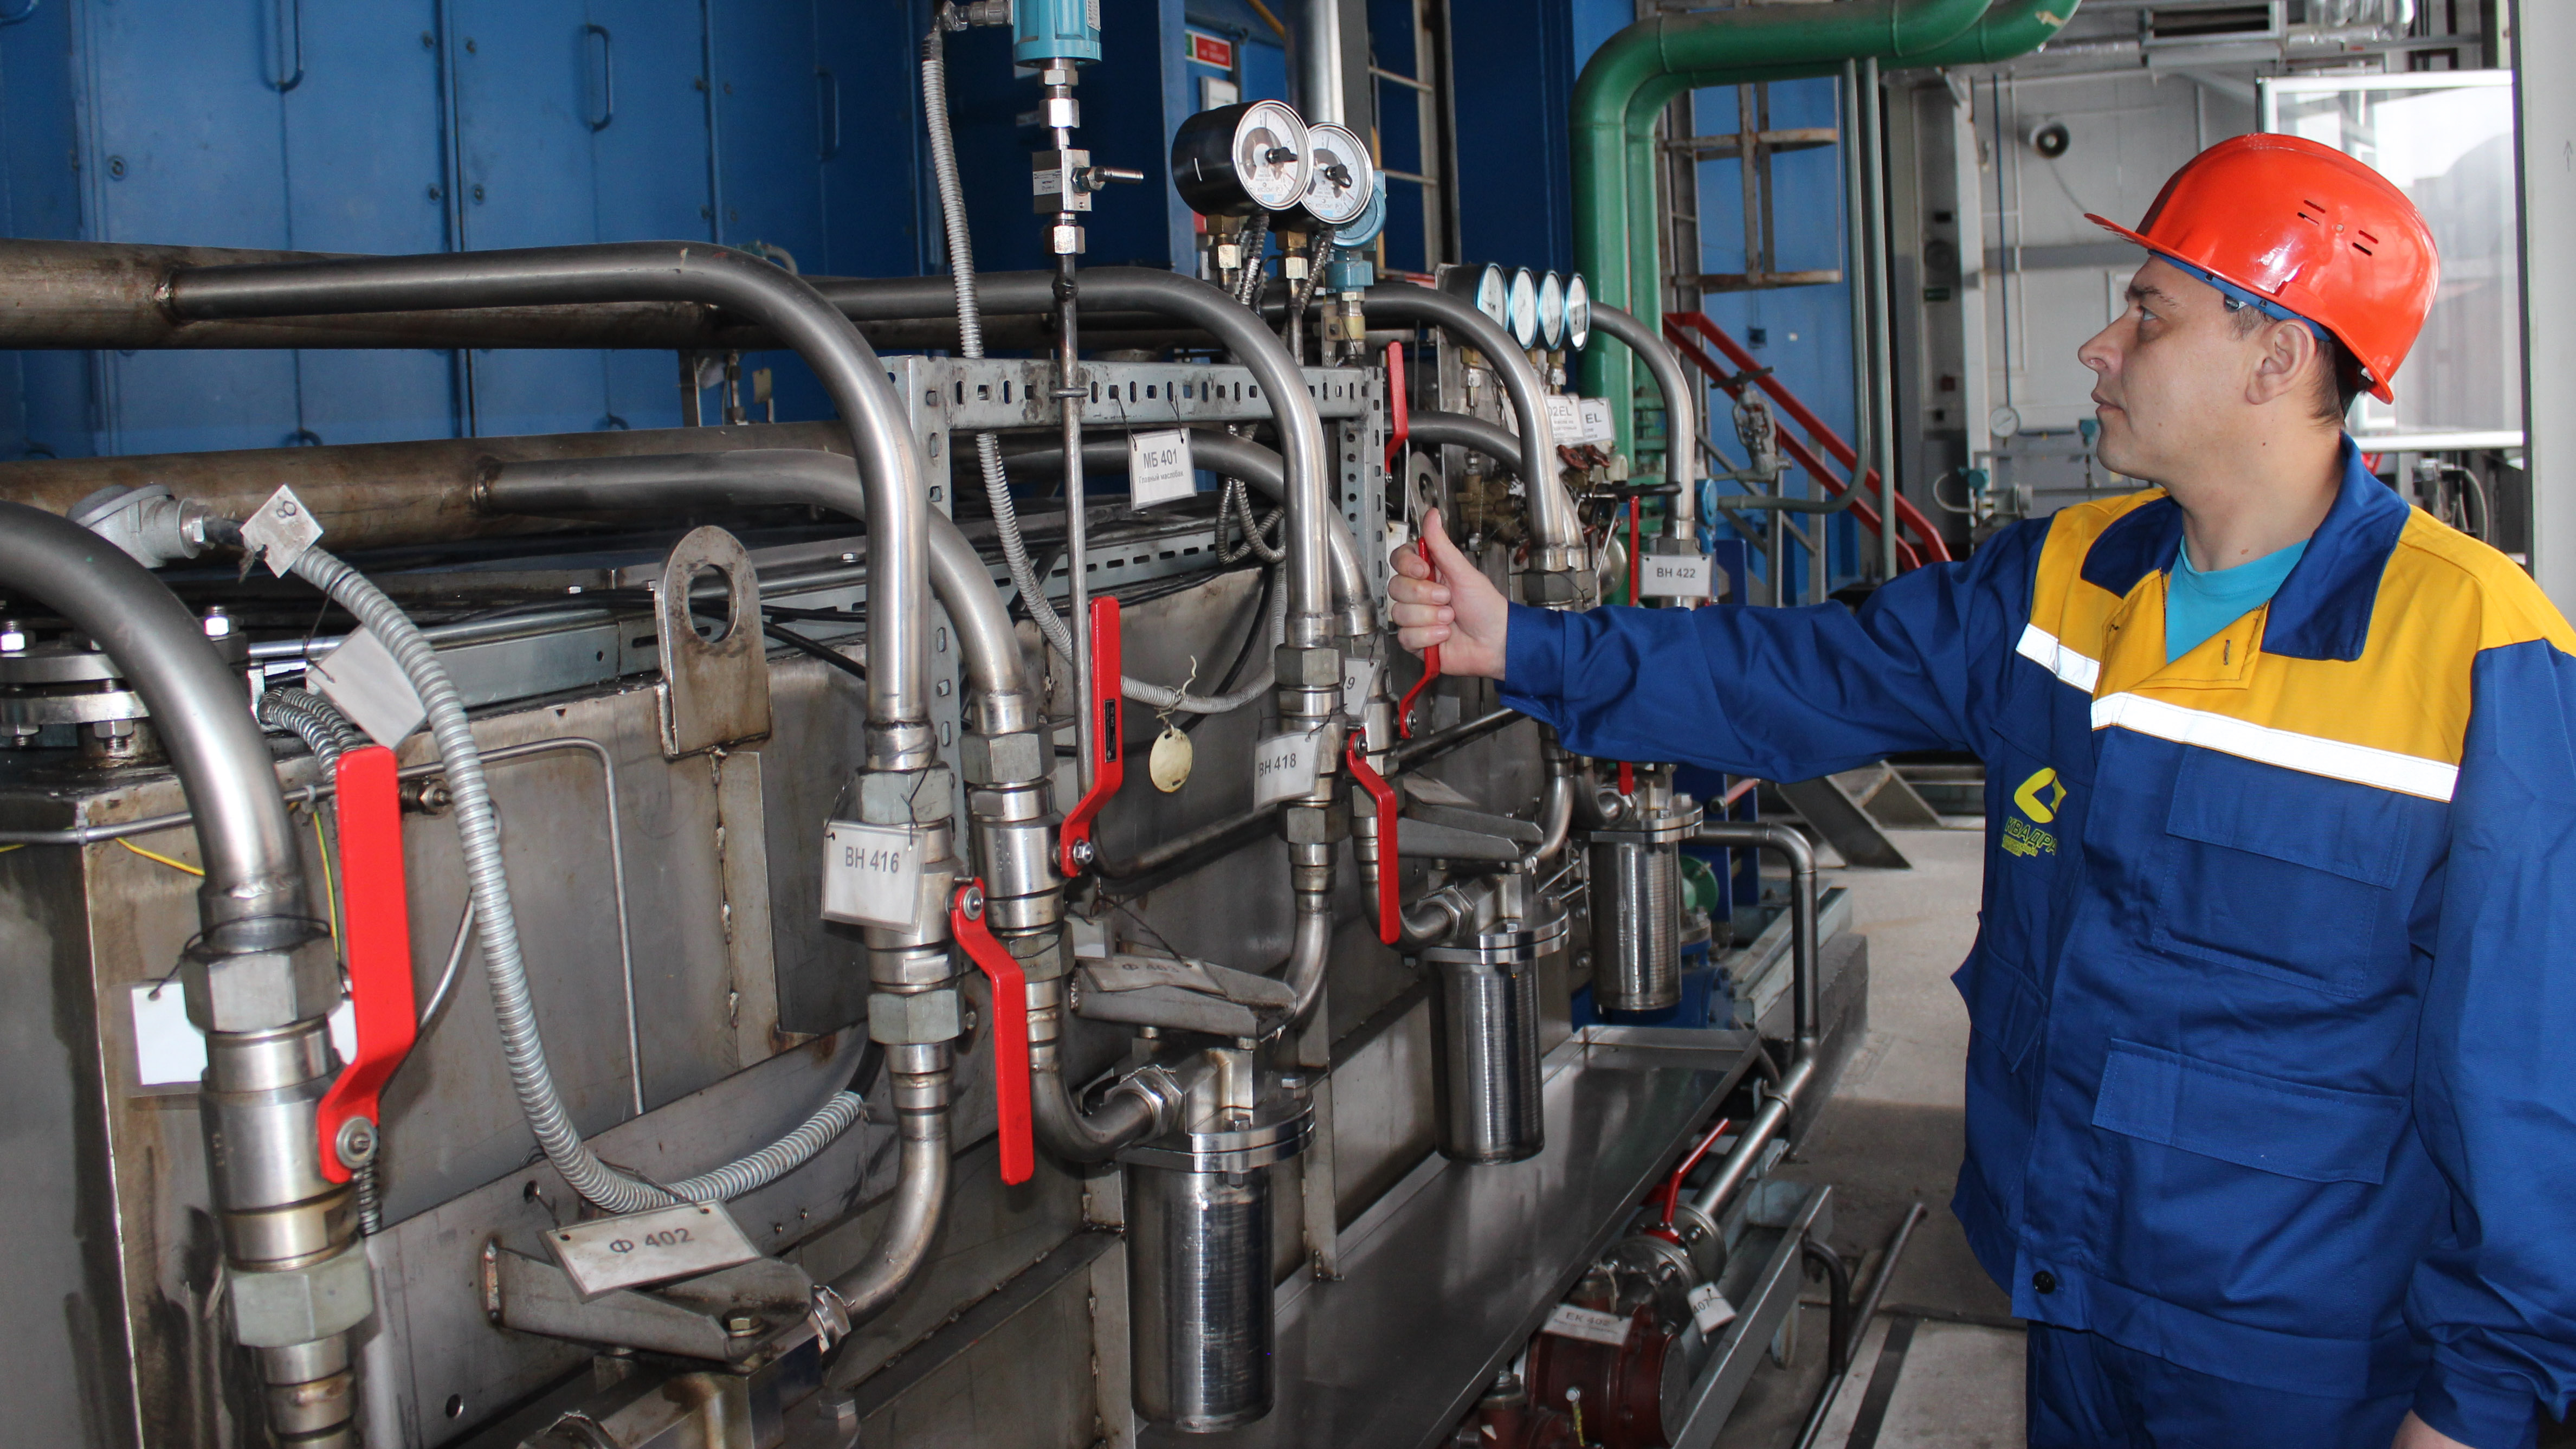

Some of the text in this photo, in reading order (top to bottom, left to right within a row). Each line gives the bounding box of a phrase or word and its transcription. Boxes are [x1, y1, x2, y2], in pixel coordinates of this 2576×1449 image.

[1586, 413, 1602, 423] EL
[1143, 448, 1177, 469] МБ 401
[1657, 568, 1696, 578] ВН 422
[1259, 752, 1296, 778] ВН 418
[2005, 816, 2057, 856] КВАДРА
[845, 846, 899, 874] ВН 416
[610, 1227, 696, 1253] Ф 402
